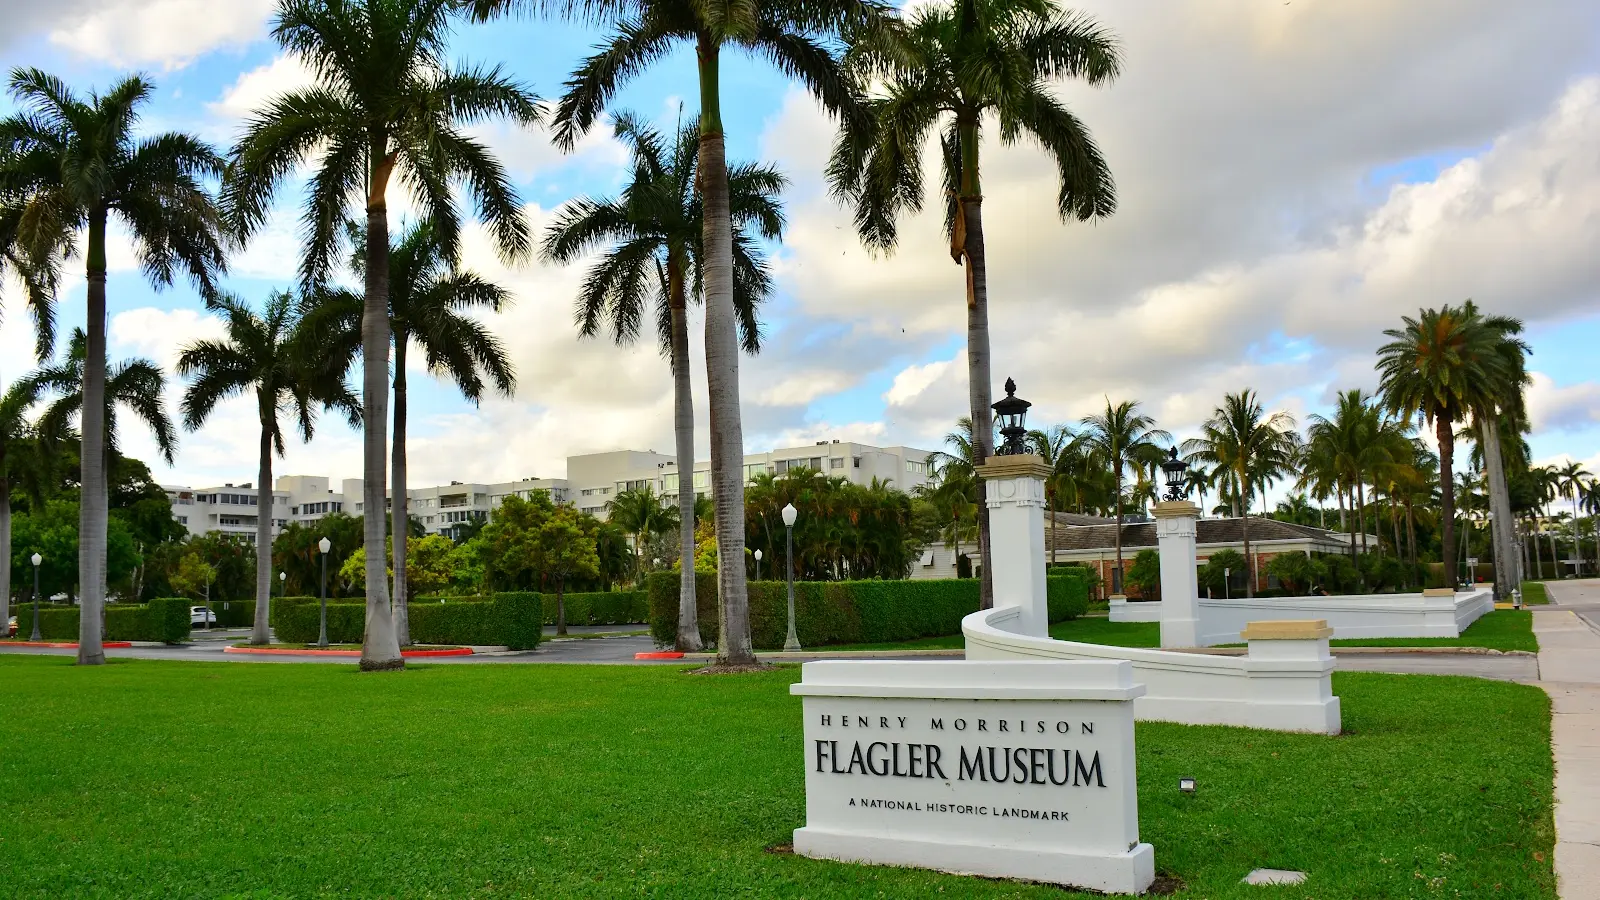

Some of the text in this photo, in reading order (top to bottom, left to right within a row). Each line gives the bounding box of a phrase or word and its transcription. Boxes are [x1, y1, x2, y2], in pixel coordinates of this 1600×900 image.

[820, 714, 1094, 735] HENRY MORRISON
[814, 739, 1108, 789] FLAGLER MUSEUM
[848, 797, 1069, 822] A NATIONAL HISTORIC LANDMARK
